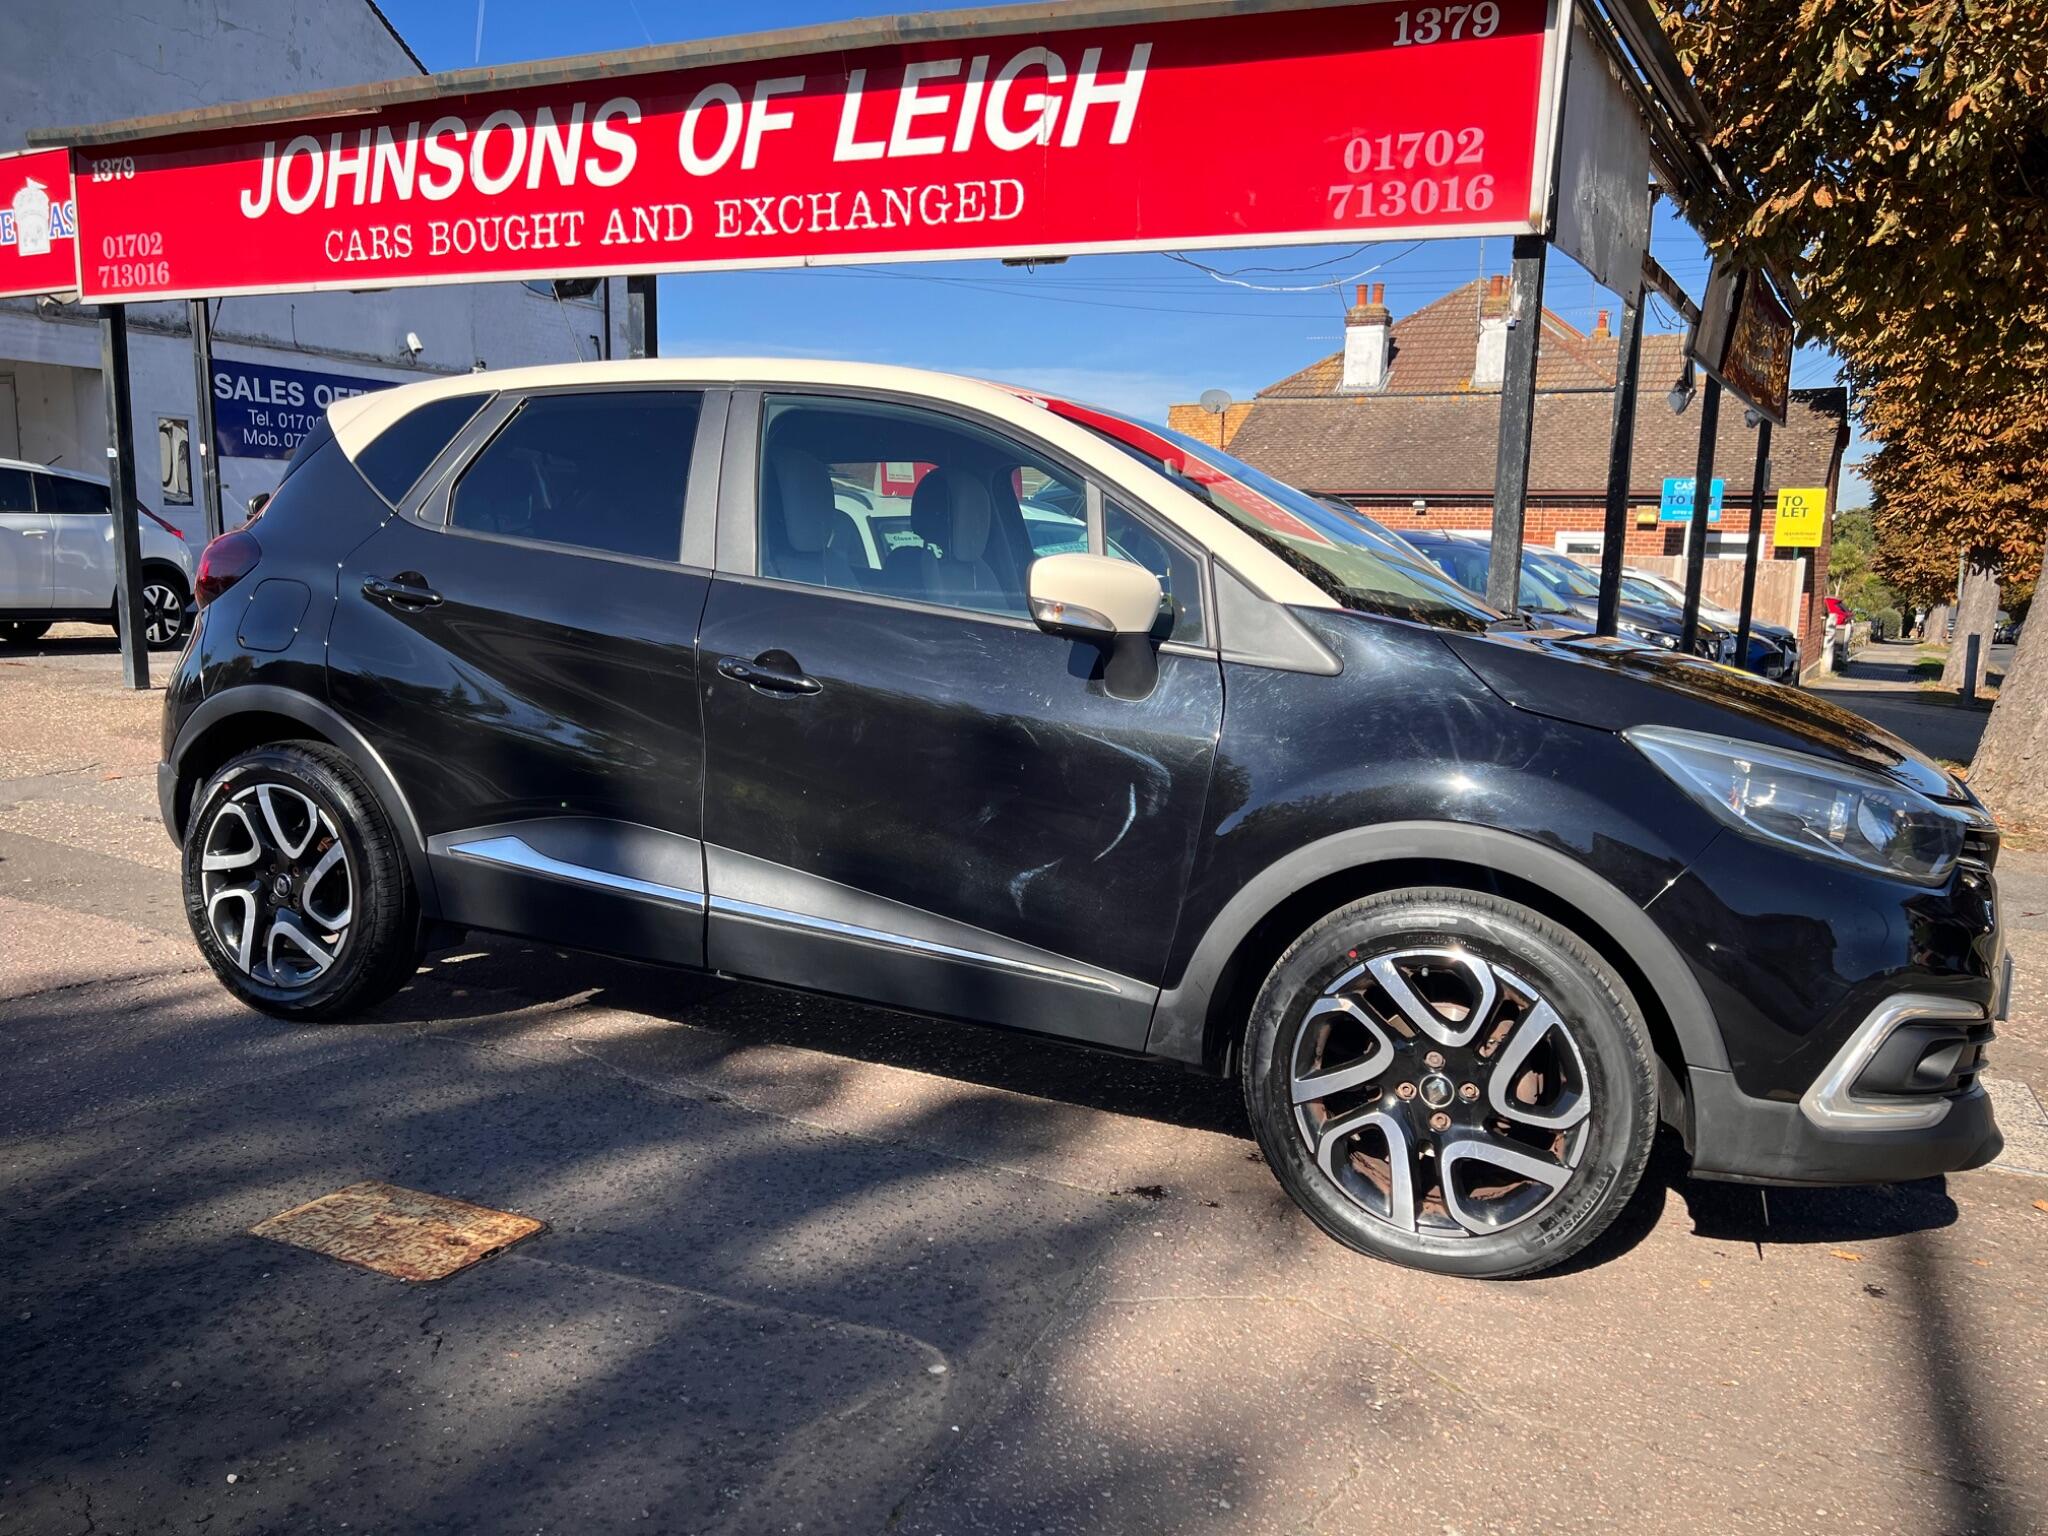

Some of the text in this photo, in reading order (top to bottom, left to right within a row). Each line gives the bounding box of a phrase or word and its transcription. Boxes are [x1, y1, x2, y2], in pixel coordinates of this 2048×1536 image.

[1392, 1, 1500, 47] 1379
[240, 43, 1153, 219] JOHNSONS OF LEIGH
[1343, 126, 1485, 174] 01702
[91, 156, 136, 183] 1379
[1327, 173, 1496, 221] 713016
[324, 178, 1025, 263] CARS BOUGHT AND EXCHANGED
[102, 232, 163, 260] 01702
[98, 261, 170, 289] 713016
[214, 373, 369, 409] SALES OF
[248, 408, 274, 428] Tel.
[243, 429, 282, 447] Mob.
[1667, 495, 1716, 505] TO LT
[1782, 507, 1809, 518] LET
[1783, 496, 1803, 507] TO
